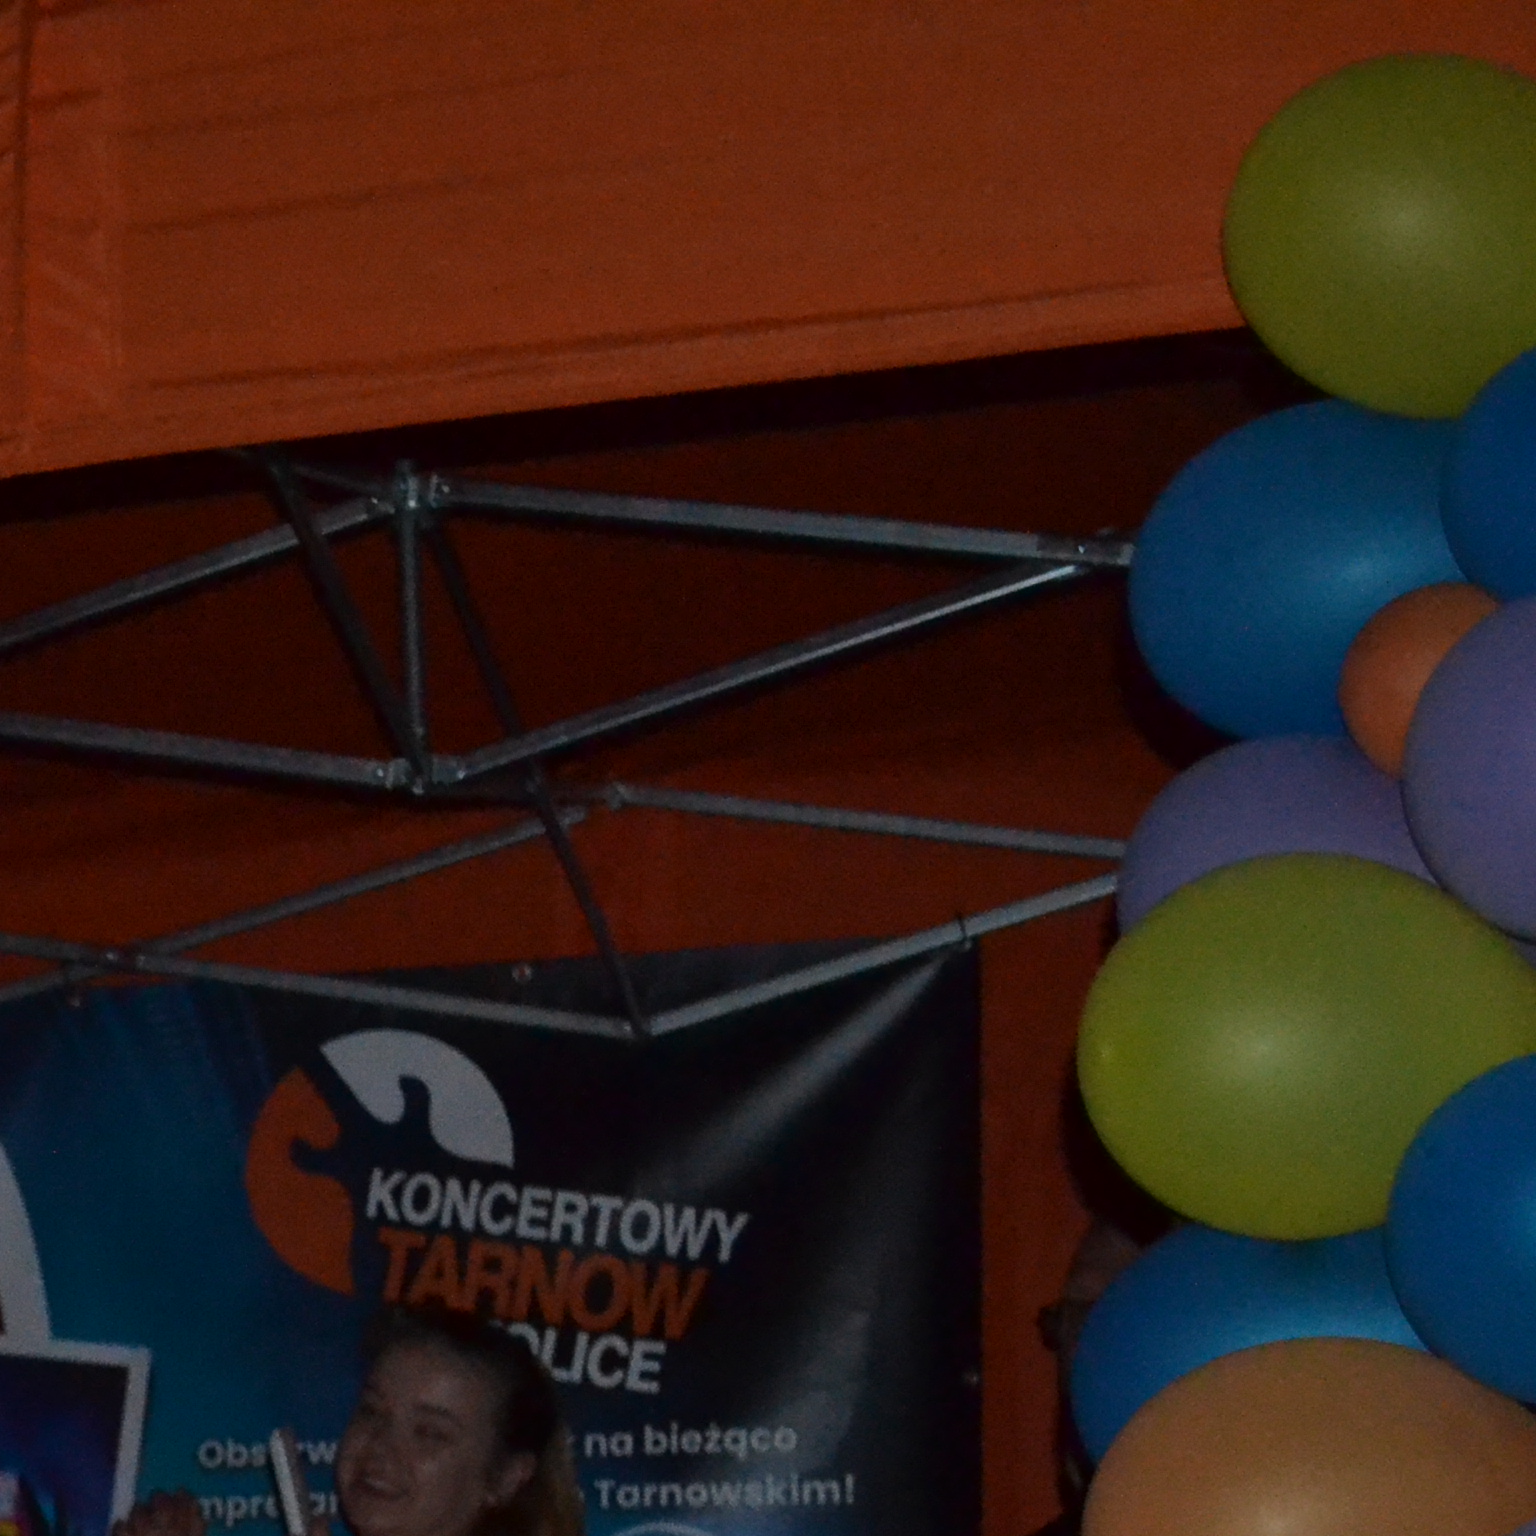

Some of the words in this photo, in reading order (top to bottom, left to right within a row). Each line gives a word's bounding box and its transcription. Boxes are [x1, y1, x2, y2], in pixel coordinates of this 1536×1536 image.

[364, 1166, 751, 1265] KONCERTOWY
[582, 1428, 635, 1460] na
[642, 1420, 799, 1460] bieżąco
[593, 1473, 857, 1511] Tarnowskim!
